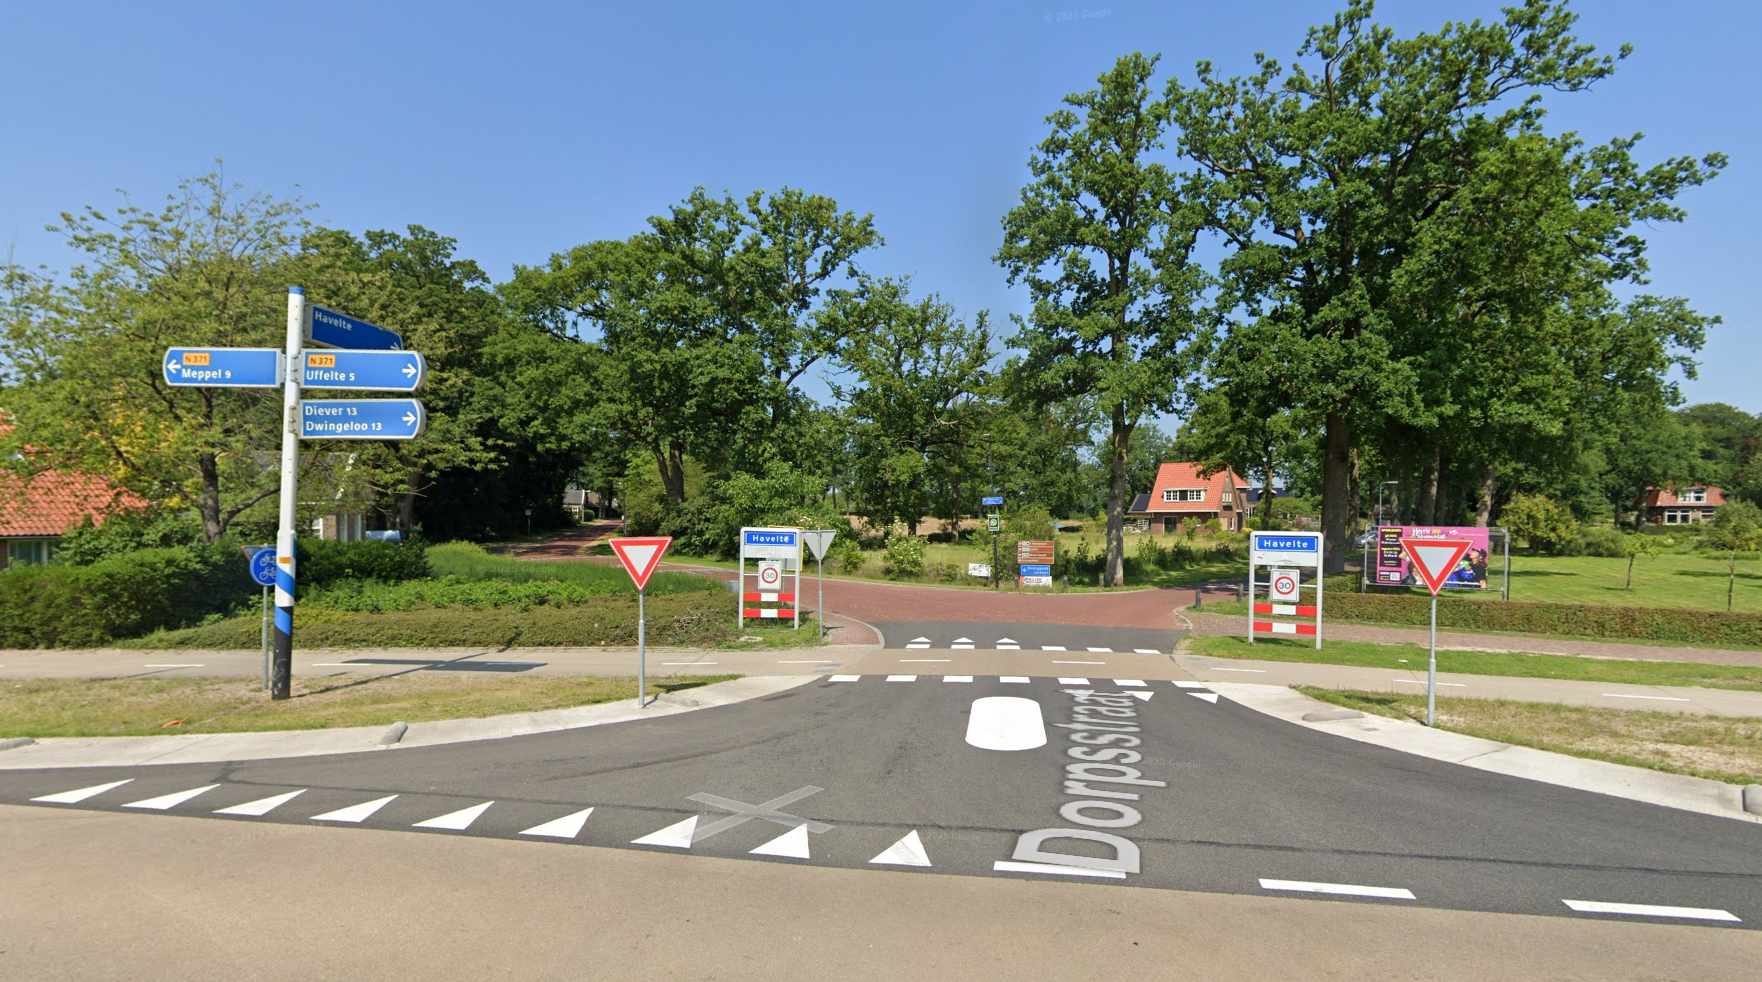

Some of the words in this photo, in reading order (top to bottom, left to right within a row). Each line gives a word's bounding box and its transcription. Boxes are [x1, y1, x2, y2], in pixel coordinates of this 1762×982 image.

[315, 311, 352, 331] Havelte
[184, 355, 192, 363] N
[193, 355, 208, 363] 371
[310, 357, 317, 365] N
[318, 357, 333, 365] 371
[181, 368, 222, 380] Meppel
[224, 370, 232, 379] 9
[306, 370, 346, 381] Uffelte
[349, 372, 355, 381] 5
[305, 406, 343, 416] Diever
[346, 407, 357, 416] 13
[306, 421, 368, 433] Dwingeloo
[371, 422, 382, 431] 13
[752, 535, 789, 543] Havelte
[1263, 539, 1309, 548] Havelte
[1278, 582, 1291, 590] 30
